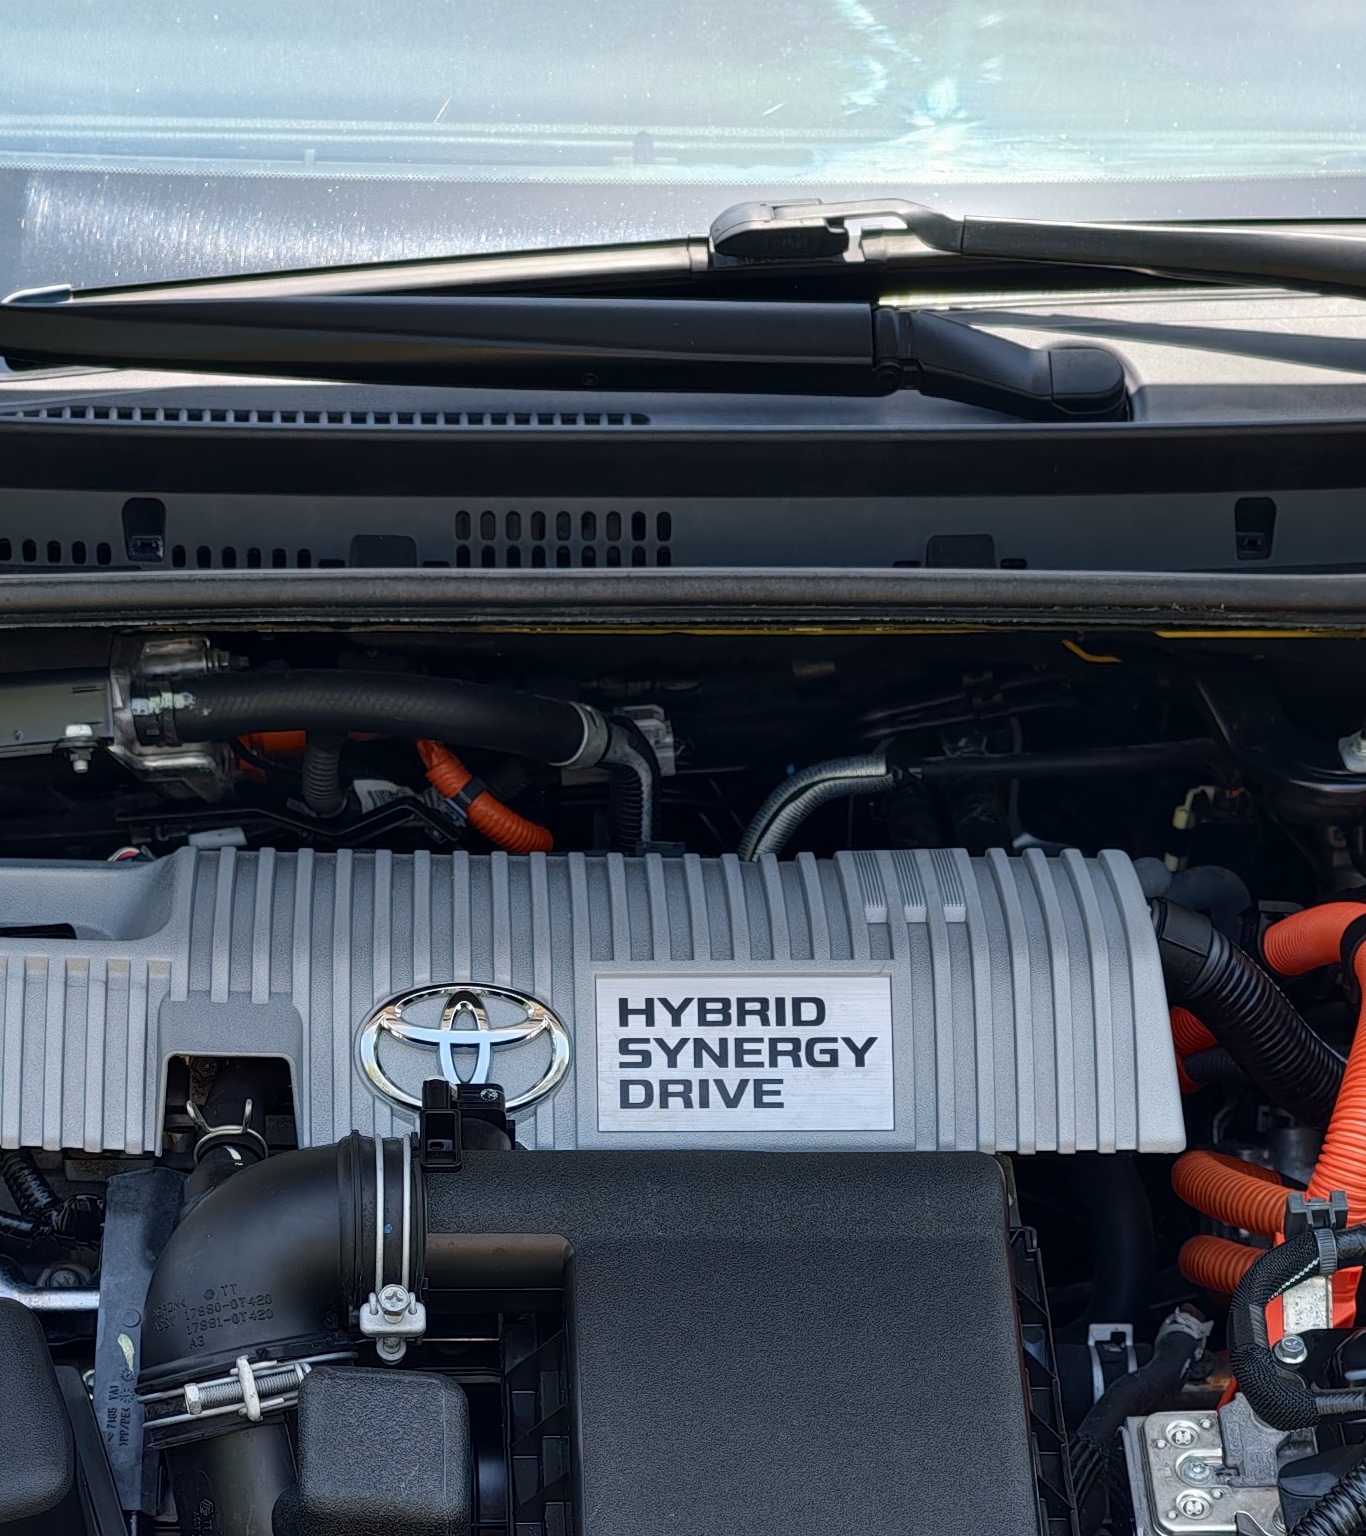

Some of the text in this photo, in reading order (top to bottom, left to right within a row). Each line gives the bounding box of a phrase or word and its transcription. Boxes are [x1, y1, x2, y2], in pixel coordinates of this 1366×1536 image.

[618, 996, 826, 1027] HYBRID
[618, 1036, 879, 1069] SYNERGY
[619, 1078, 785, 1110] DRIVE
